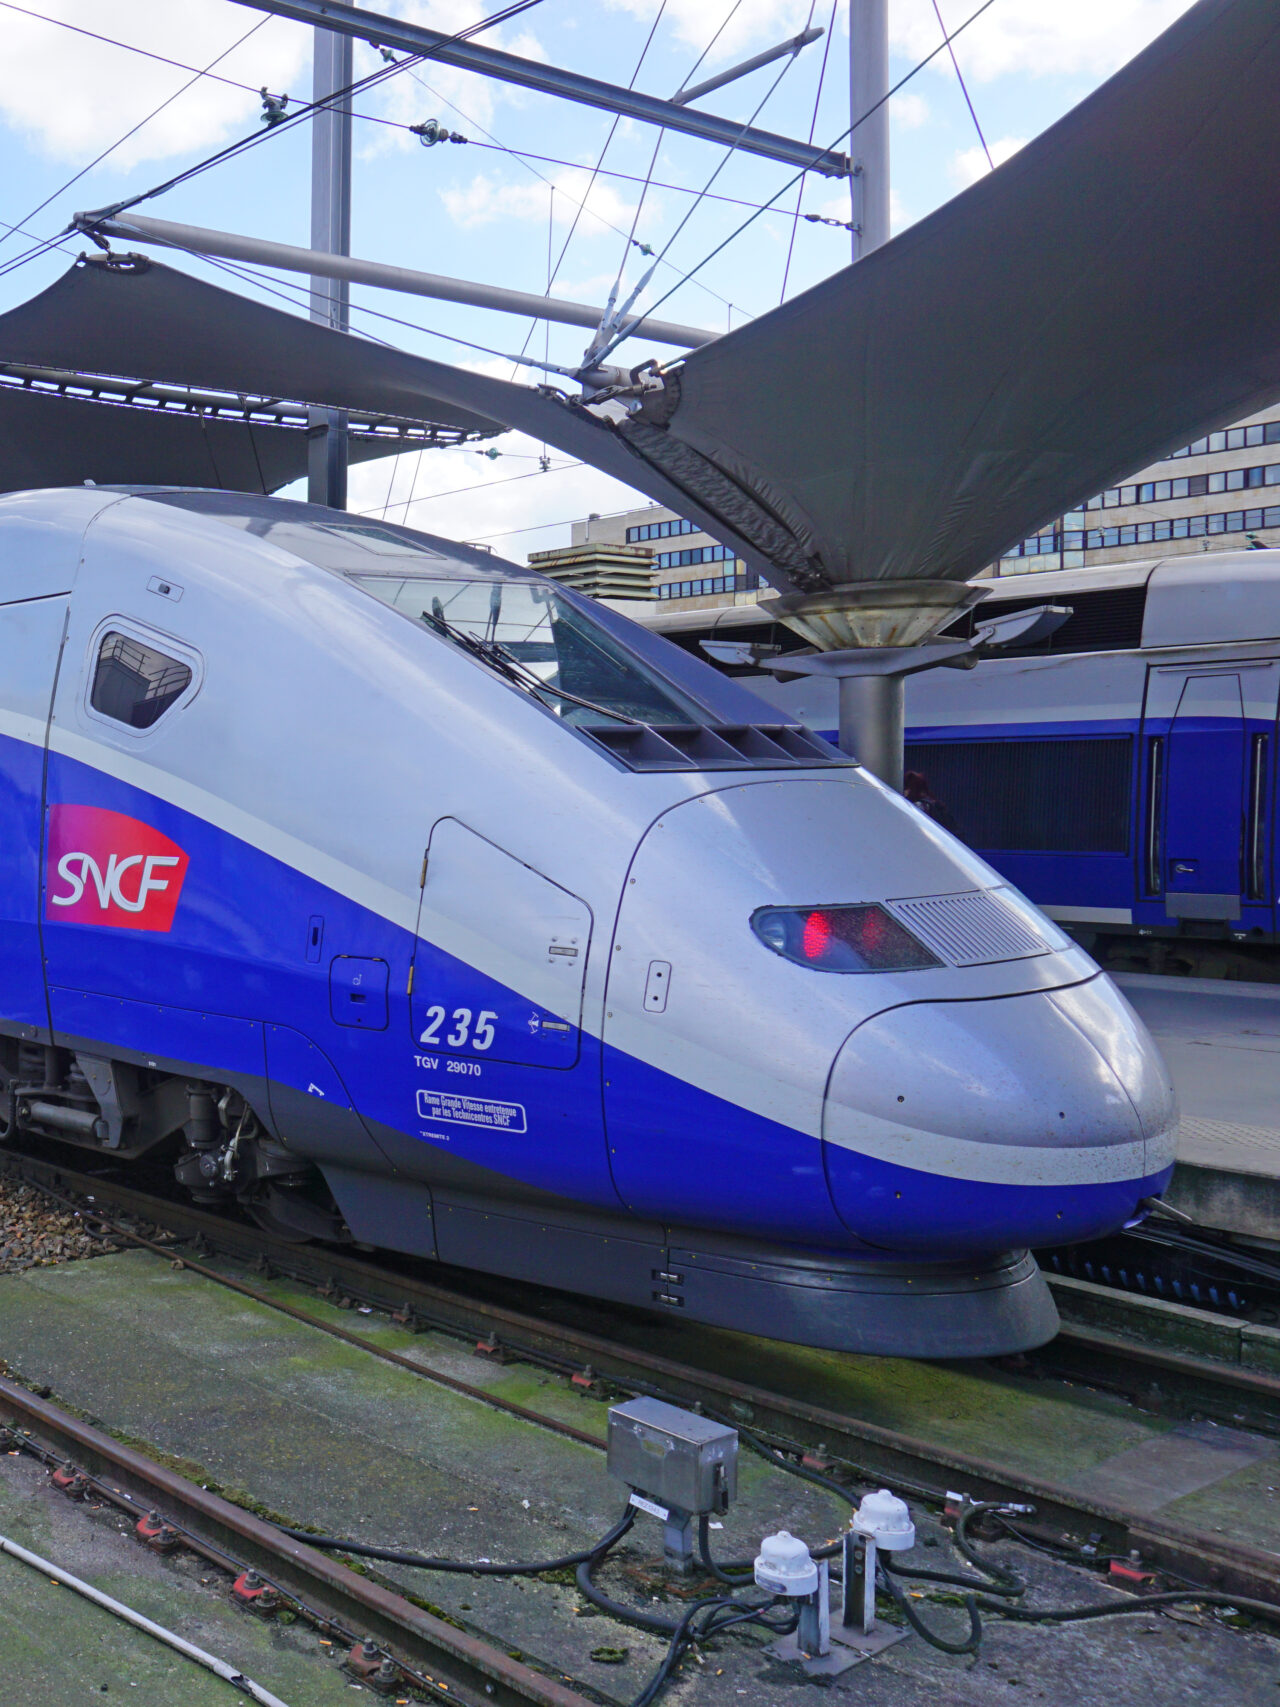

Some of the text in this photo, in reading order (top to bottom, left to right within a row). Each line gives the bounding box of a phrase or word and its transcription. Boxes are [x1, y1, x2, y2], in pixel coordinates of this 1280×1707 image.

[52, 852, 180, 912] SNCF
[420, 1005, 499, 1050] 235
[413, 1055, 481, 1076] TGV 29070
[424, 1092, 517, 1117] Rame Grande Vitesse entretenue
[431, 1105, 511, 1126] par les Technicentres SNCF
